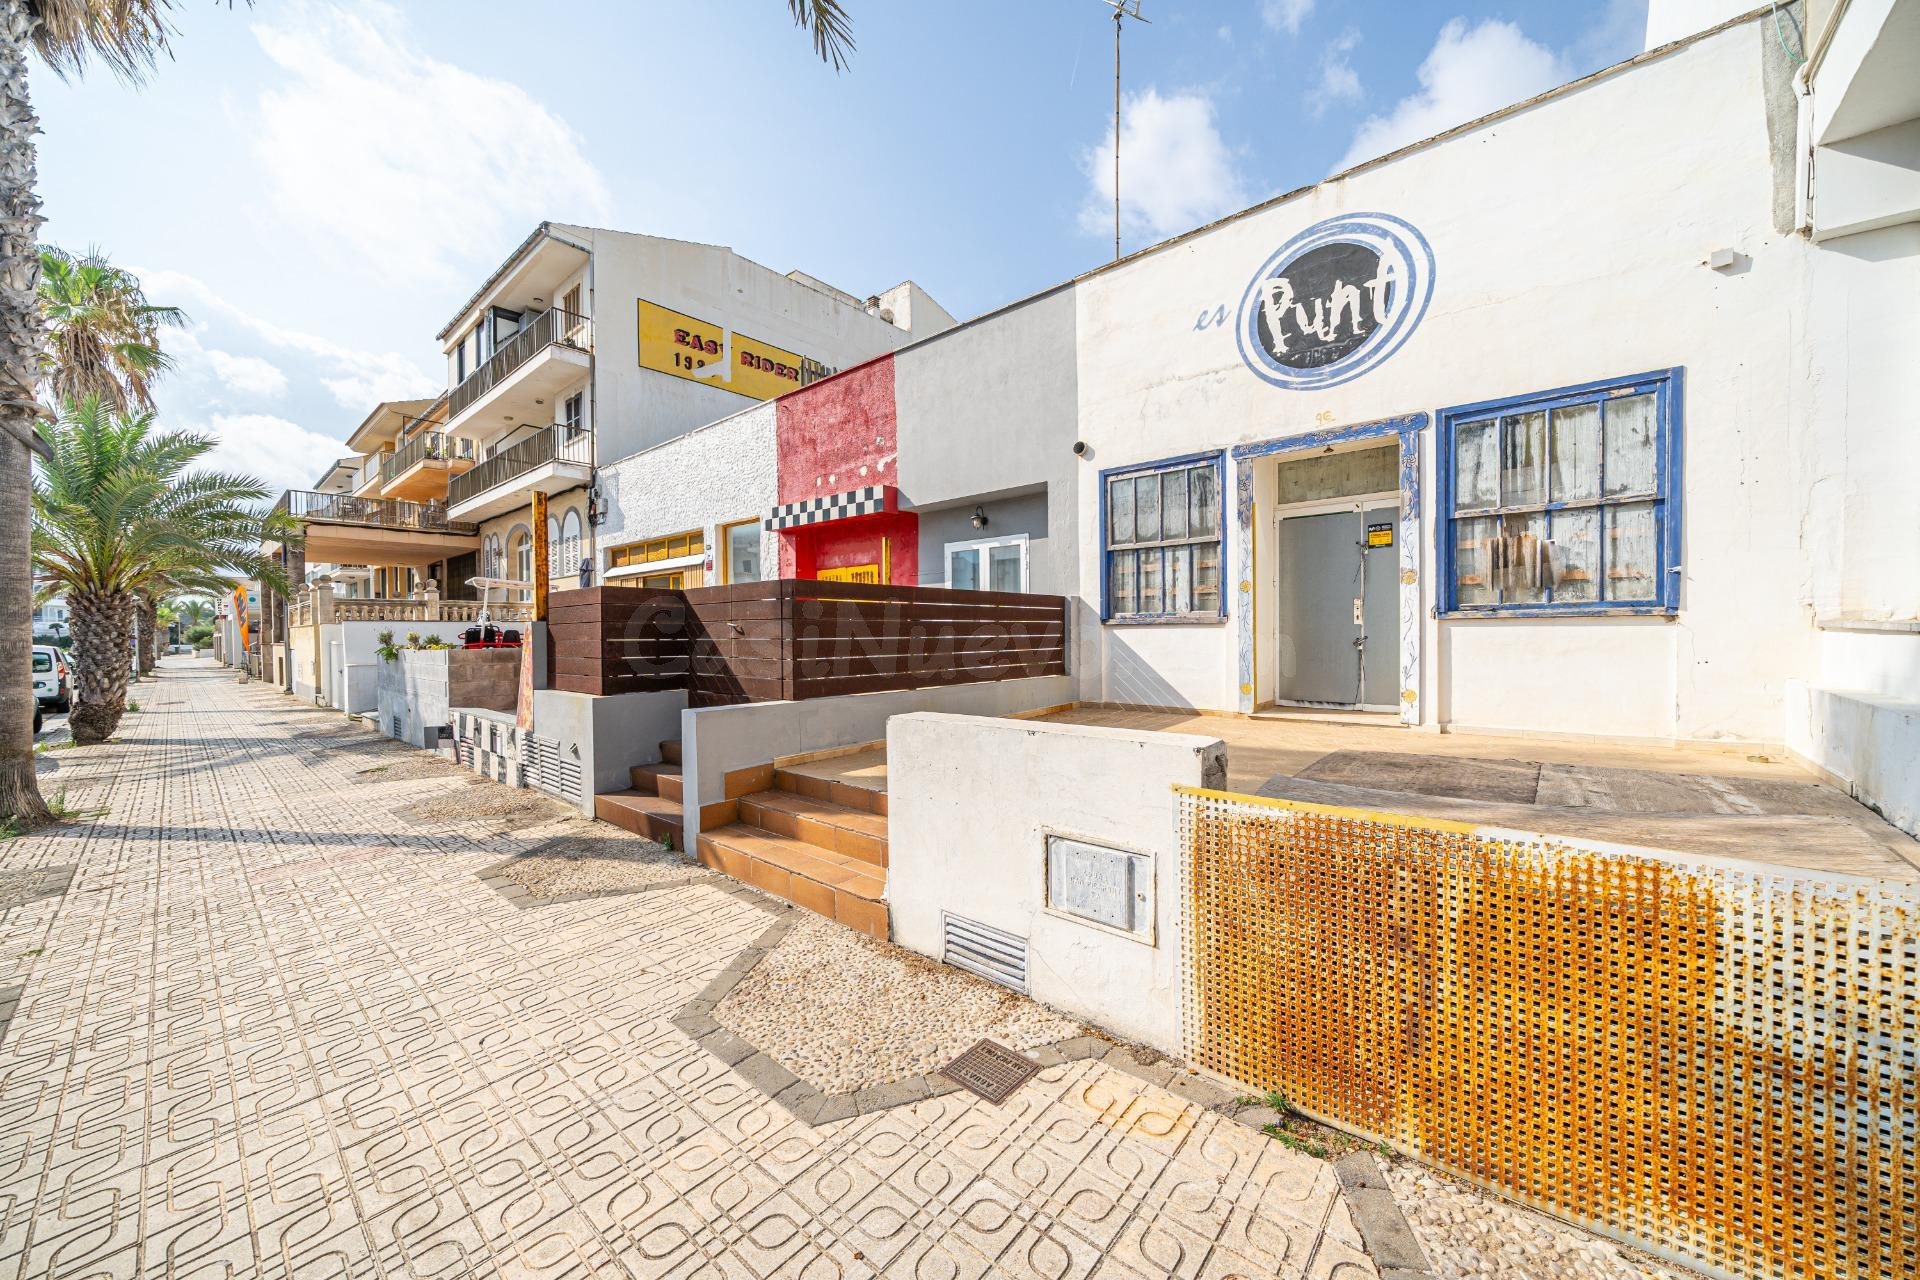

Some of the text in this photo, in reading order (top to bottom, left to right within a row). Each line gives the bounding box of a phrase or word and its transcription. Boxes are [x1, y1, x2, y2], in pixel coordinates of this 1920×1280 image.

[1261, 235, 1397, 353] Punt
[674, 328, 799, 381] EAS RIDER
